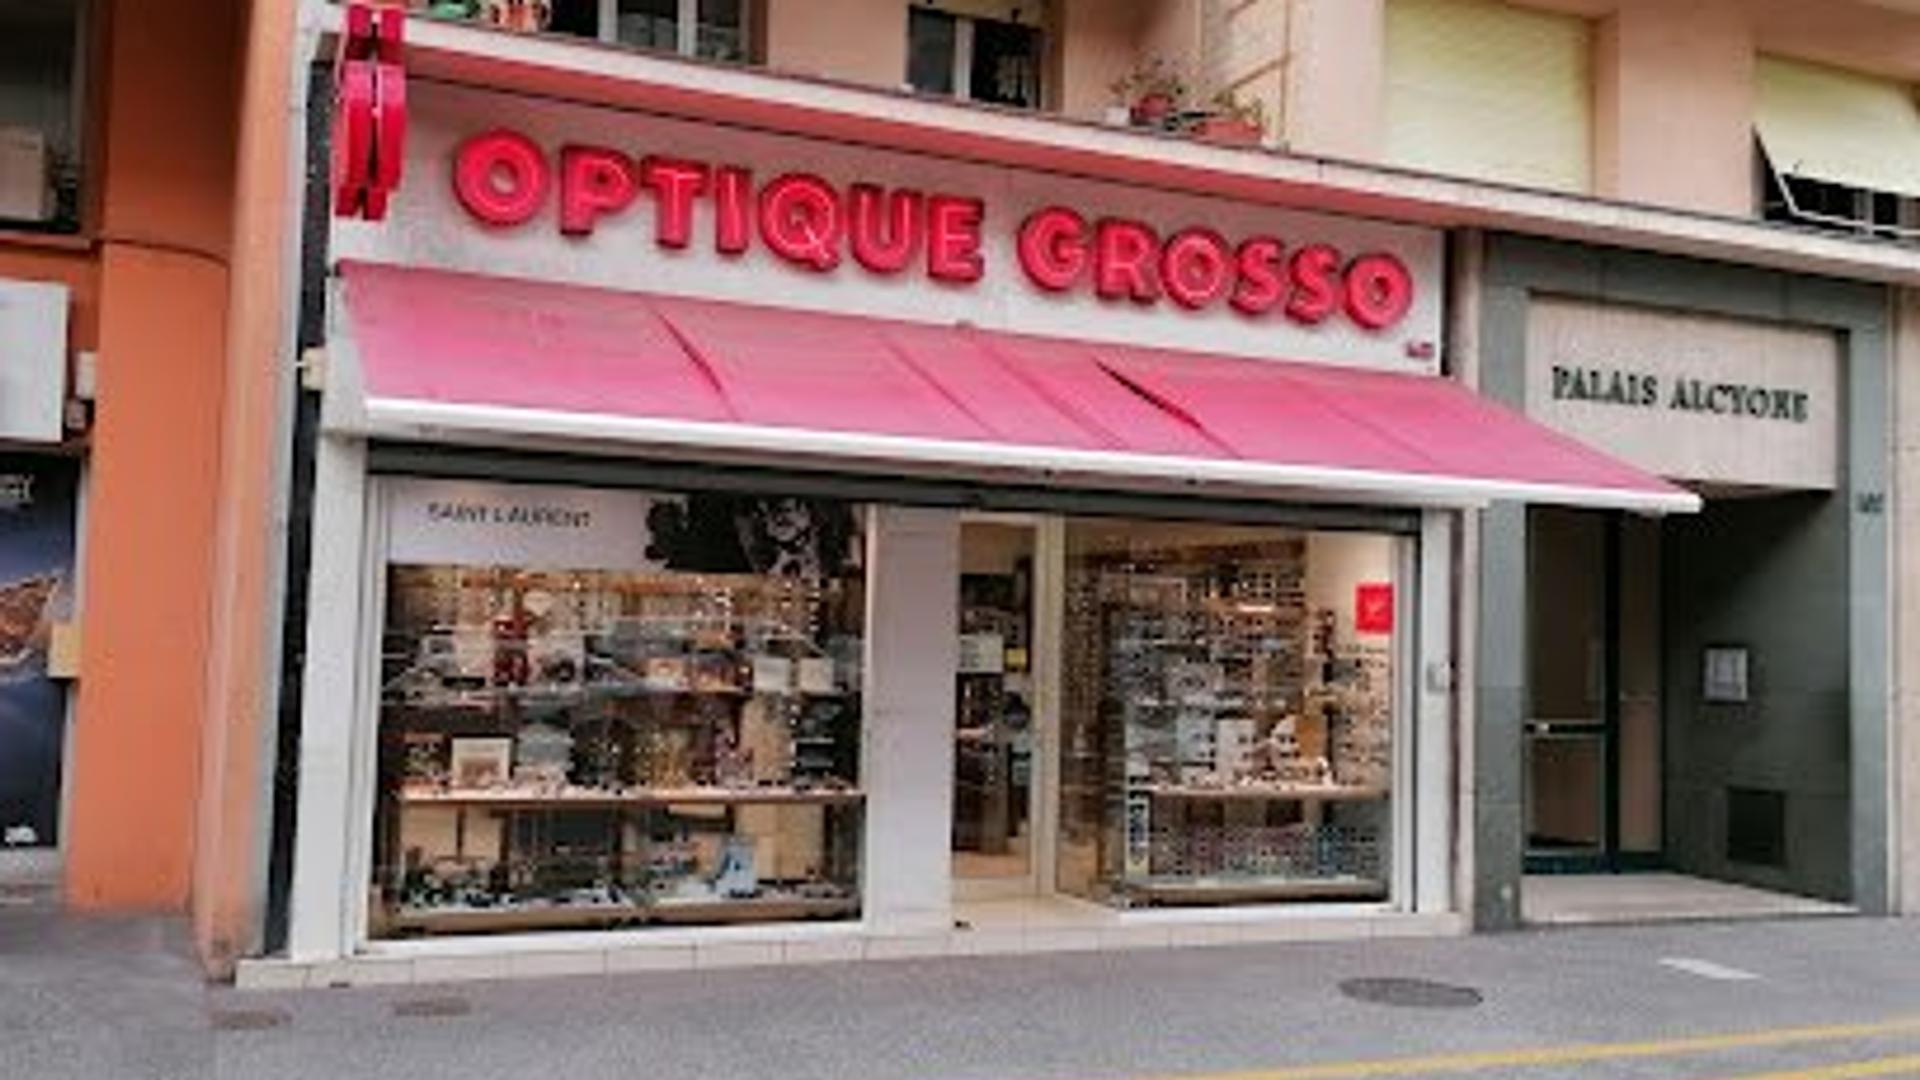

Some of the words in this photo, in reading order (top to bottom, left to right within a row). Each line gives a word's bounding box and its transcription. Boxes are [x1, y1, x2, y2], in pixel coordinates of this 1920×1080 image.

[453, 128, 985, 283] OPTIQUE
[1018, 206, 1413, 331] GROSSO
[1552, 365, 1659, 407] PALAIS
[427, 501, 488, 524] SAINT
